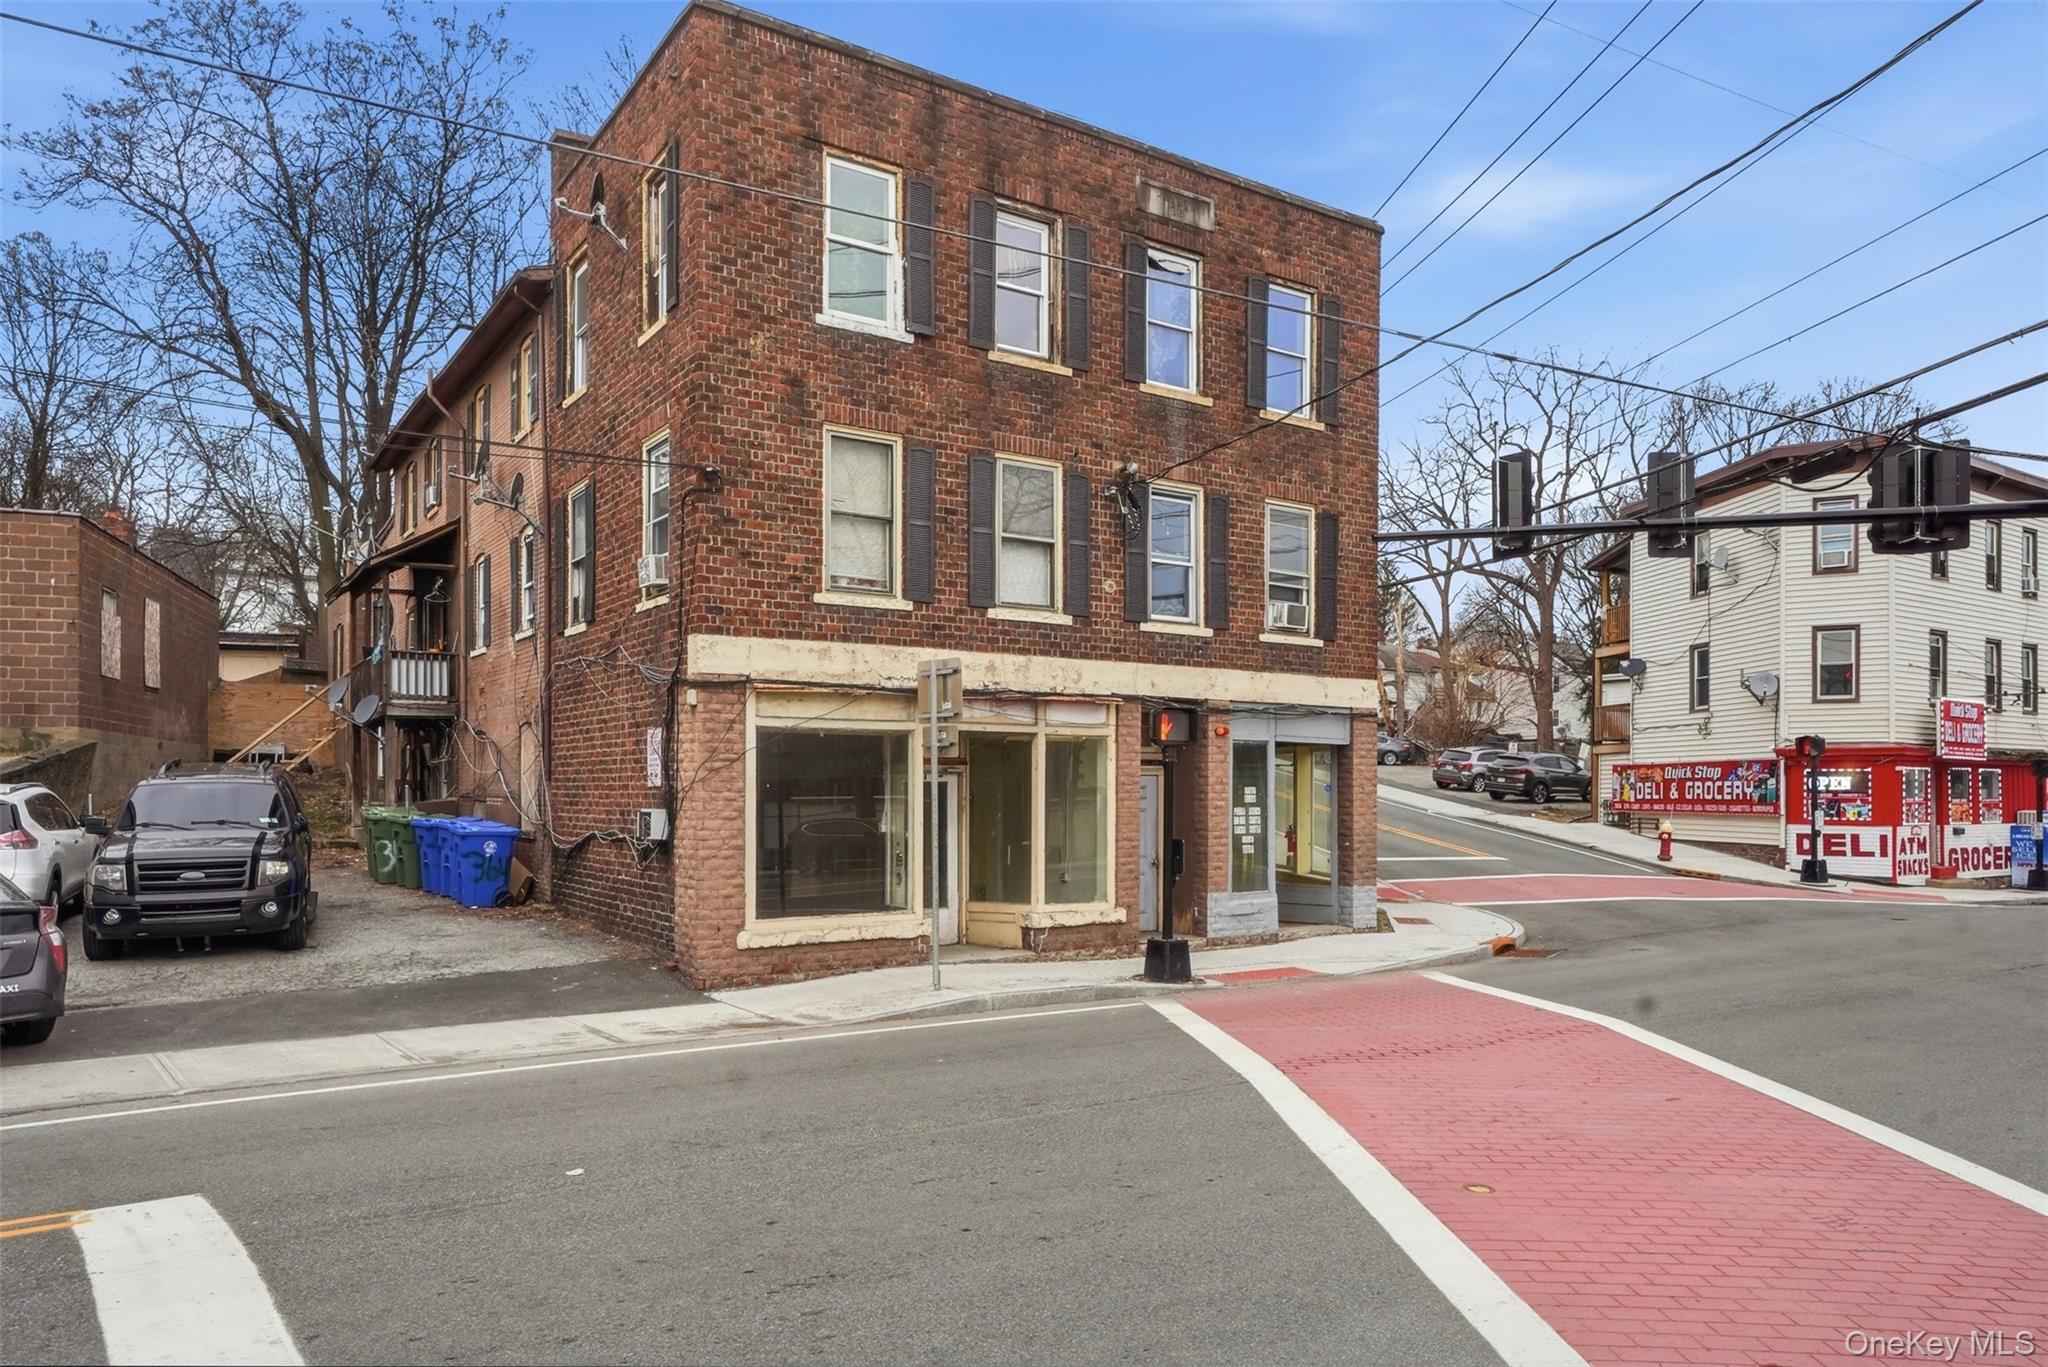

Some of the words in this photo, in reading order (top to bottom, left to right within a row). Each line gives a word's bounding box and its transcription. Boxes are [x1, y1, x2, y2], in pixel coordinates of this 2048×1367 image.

[1664, 766, 1692, 779] Quick
[1695, 765, 1721, 780] Stop
[1636, 781, 1663, 800] DELI
[1669, 782, 1679, 799] &
[1685, 780, 1754, 800] GROCERY
[1808, 776, 1852, 790] OPEN
[1796, 833, 1888, 857] DELI
[1899, 836, 1927, 855] ATM
[1898, 858, 1929, 876] SNACKS
[1949, 846, 2012, 872] GROCER
[0, 984, 20, 993] AXI
